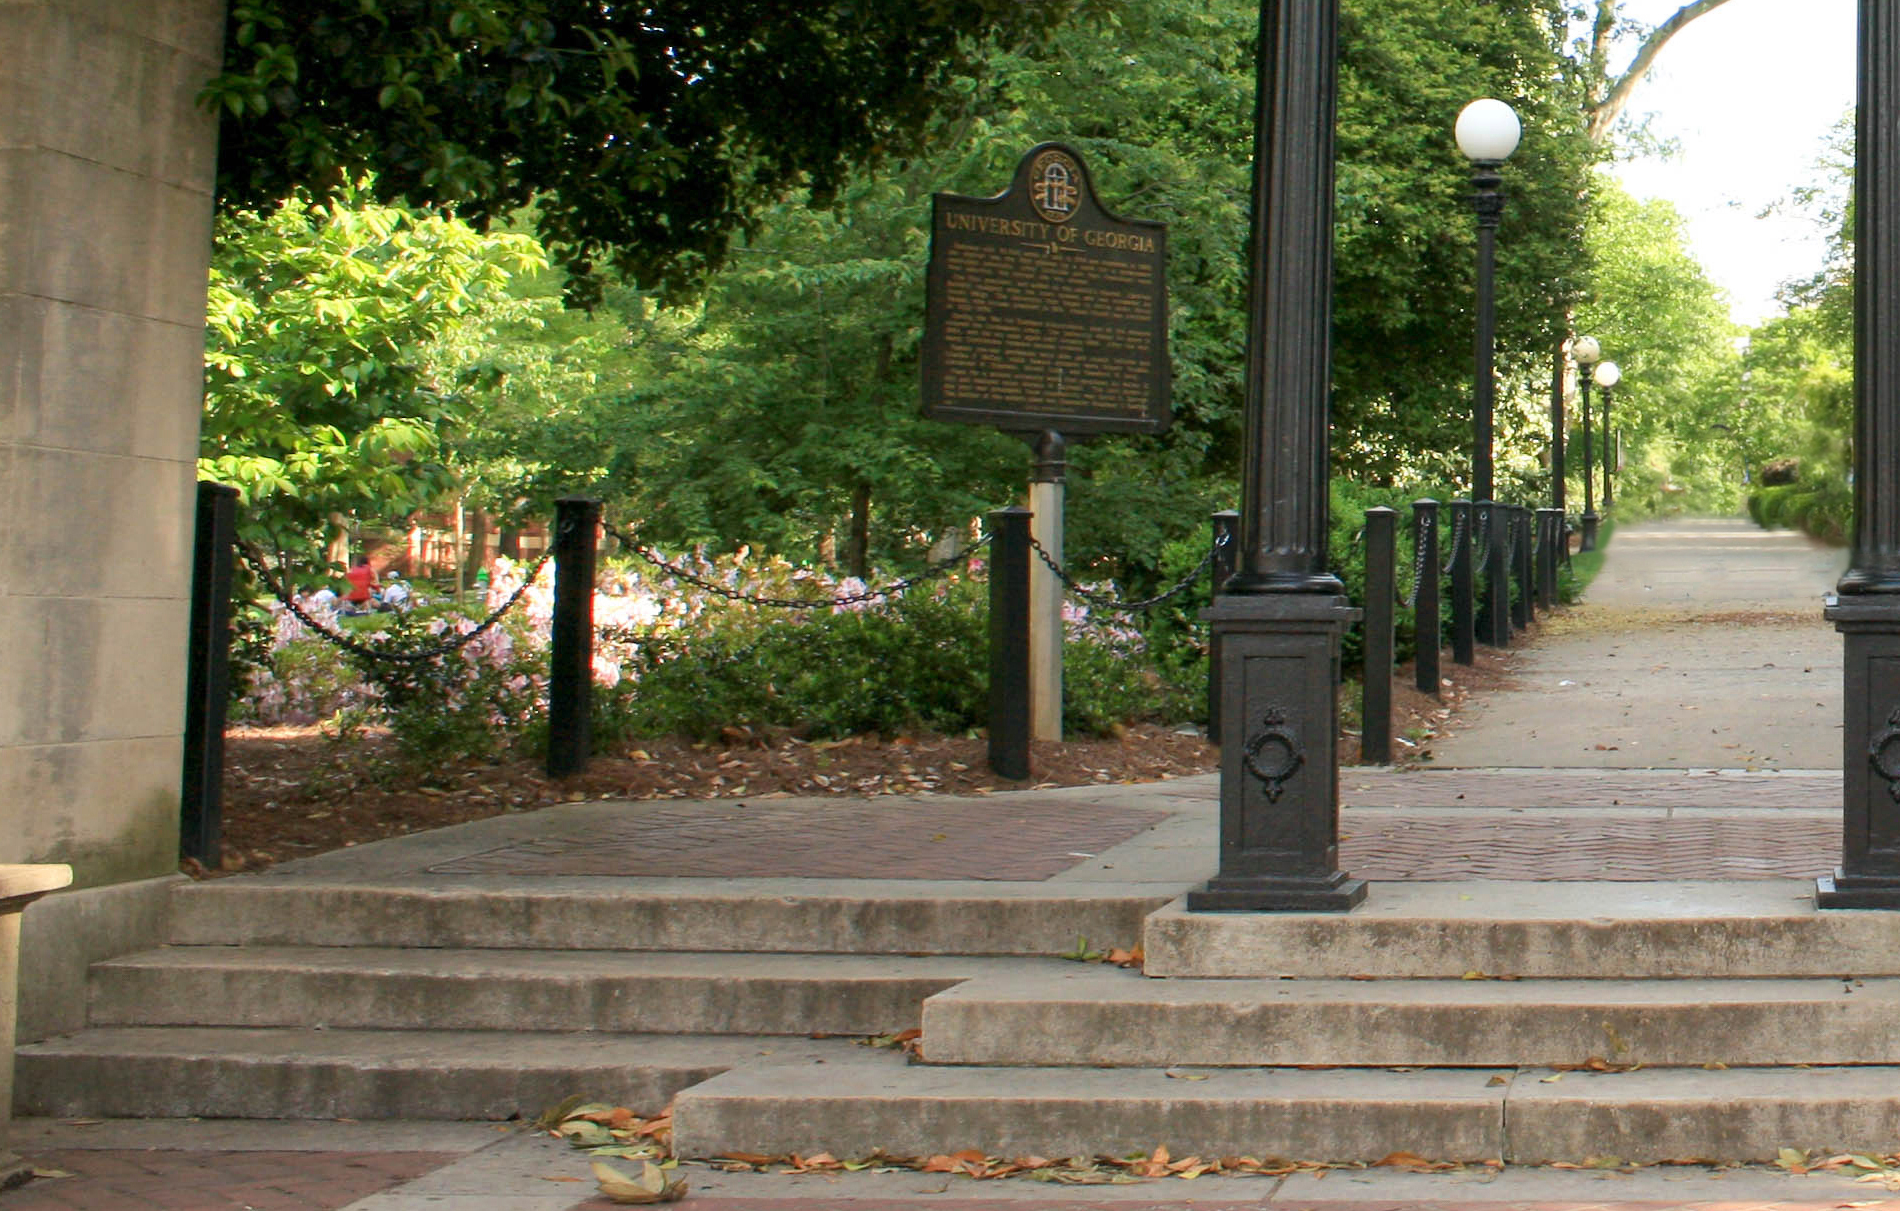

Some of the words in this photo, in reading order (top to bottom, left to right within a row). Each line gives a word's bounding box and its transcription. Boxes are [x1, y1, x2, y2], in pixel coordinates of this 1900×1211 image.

[945, 212, 1050, 239] UNIVERSITY
[1056, 226, 1078, 243] OF
[1084, 230, 1155, 252] GEORGIA
